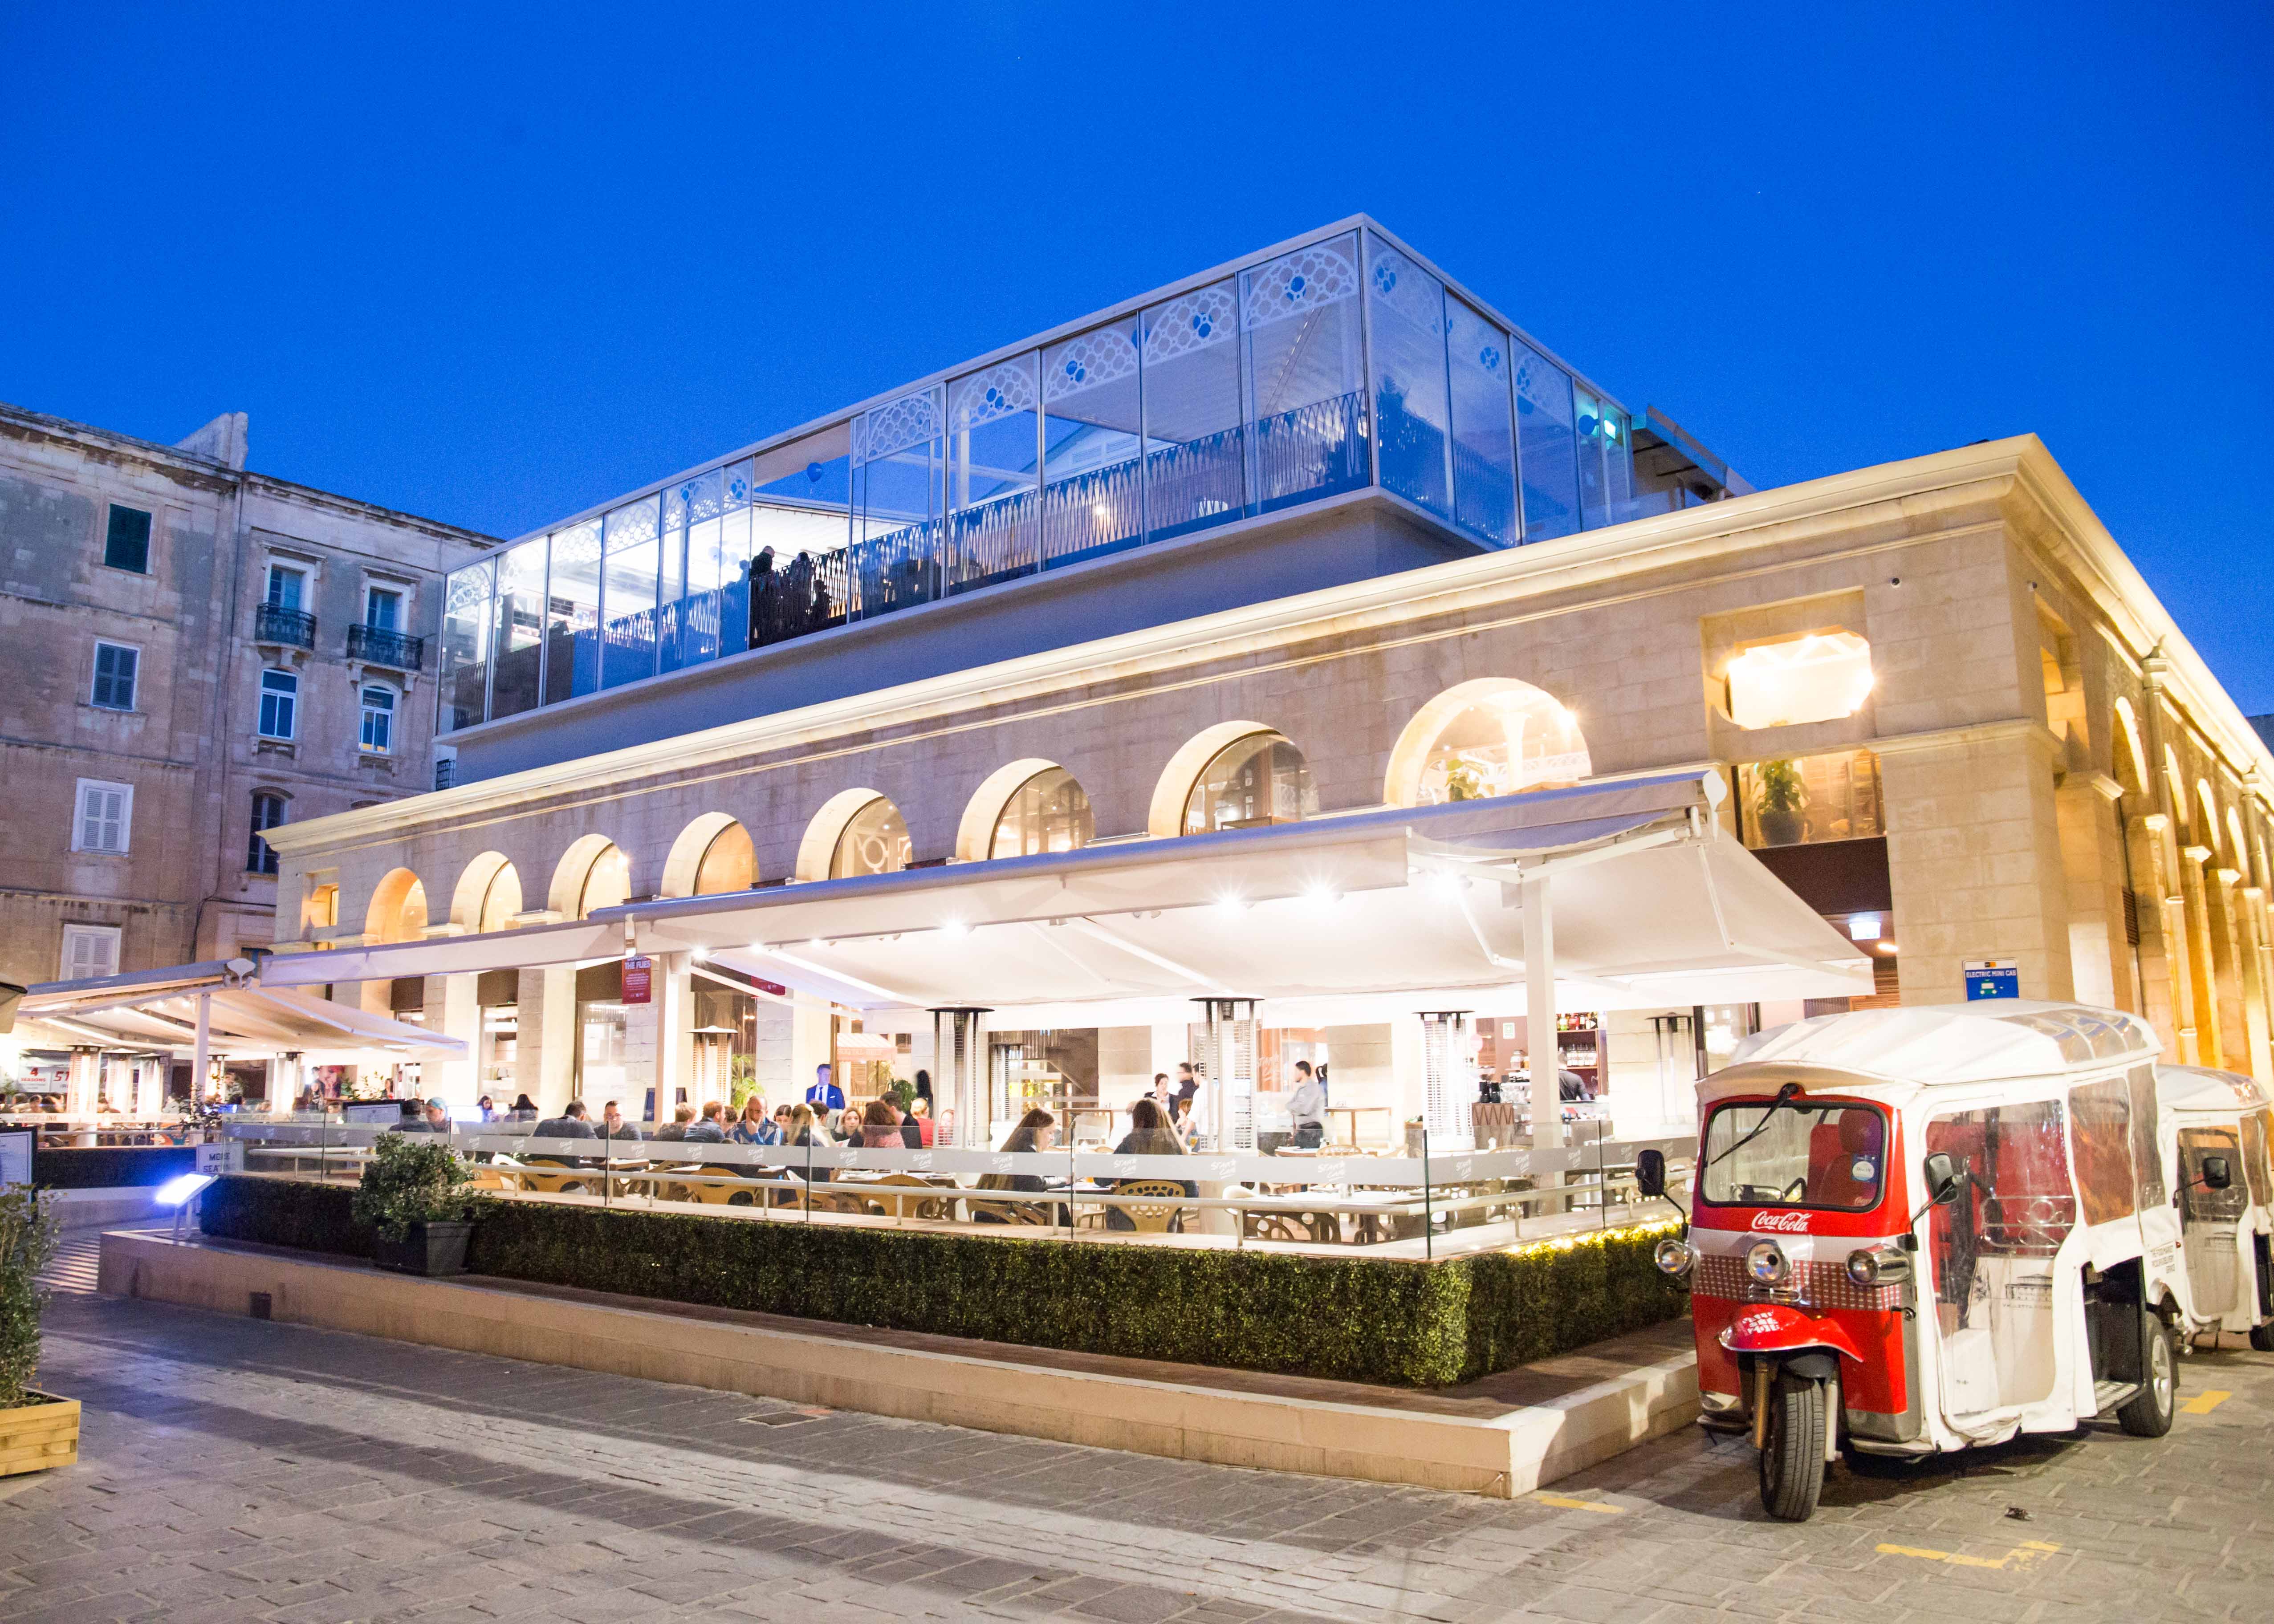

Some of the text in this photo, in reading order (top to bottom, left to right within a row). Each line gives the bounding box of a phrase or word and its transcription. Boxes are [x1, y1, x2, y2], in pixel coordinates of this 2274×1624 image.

[636, 960, 651, 969] FLIES
[30, 1067, 39, 1076] 4
[1751, 1211, 1813, 1232] Coca-Cola
